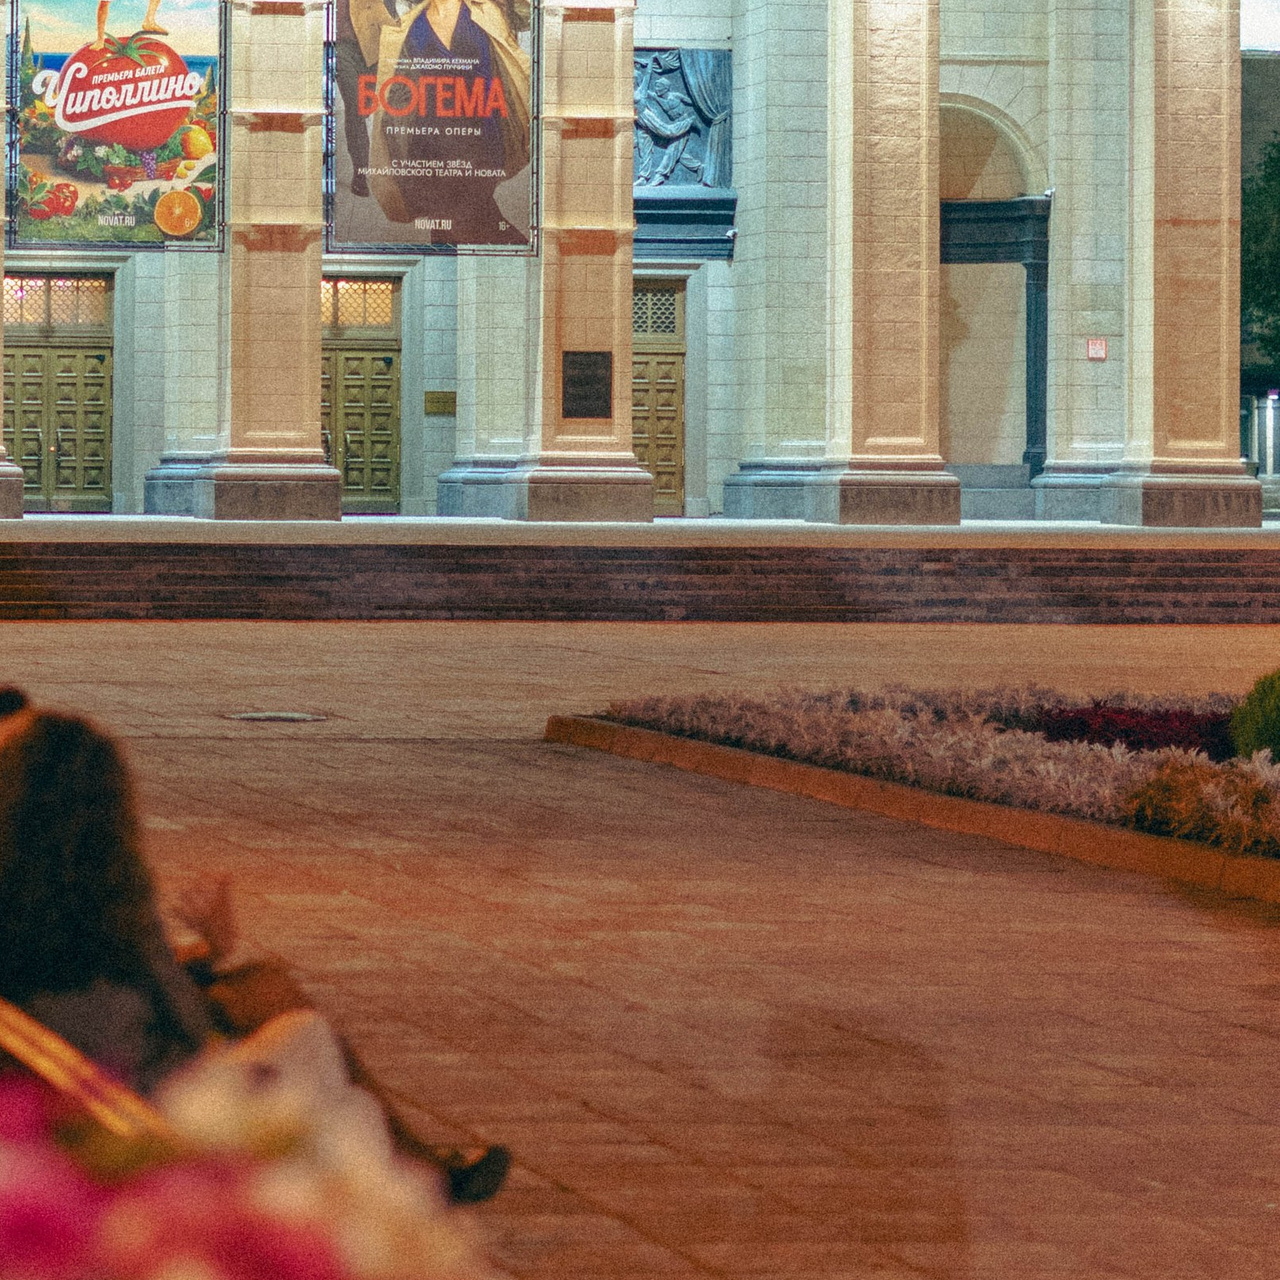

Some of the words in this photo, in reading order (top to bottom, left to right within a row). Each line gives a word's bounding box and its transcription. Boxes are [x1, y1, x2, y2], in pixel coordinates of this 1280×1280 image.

[91, 69, 133, 85] ПРЕМЬЕРА
[135, 64, 165, 78] БАЛЕТА
[32, 62, 204, 133] Чиполлино
[357, 74, 509, 118] БОГЕМА
[386, 126, 440, 135] ПРЕМЬЕРА
[445, 127, 481, 136] ОПЕРЫ
[391, 160, 398, 168] С
[400, 160, 444, 168] УЧАСТИЕМ
[446, 159, 473, 169] ЗВЁЗД
[358, 167, 433, 177] МИХАЙЛОВСКОГО
[435, 168, 463, 177] ТЕАТРА
[465, 169, 472, 177] И
[474, 169, 507, 177] НОВАТА
[98, 215, 136, 227] NOVAT.RU
[414, 219, 452, 230] NOVAT.RU
